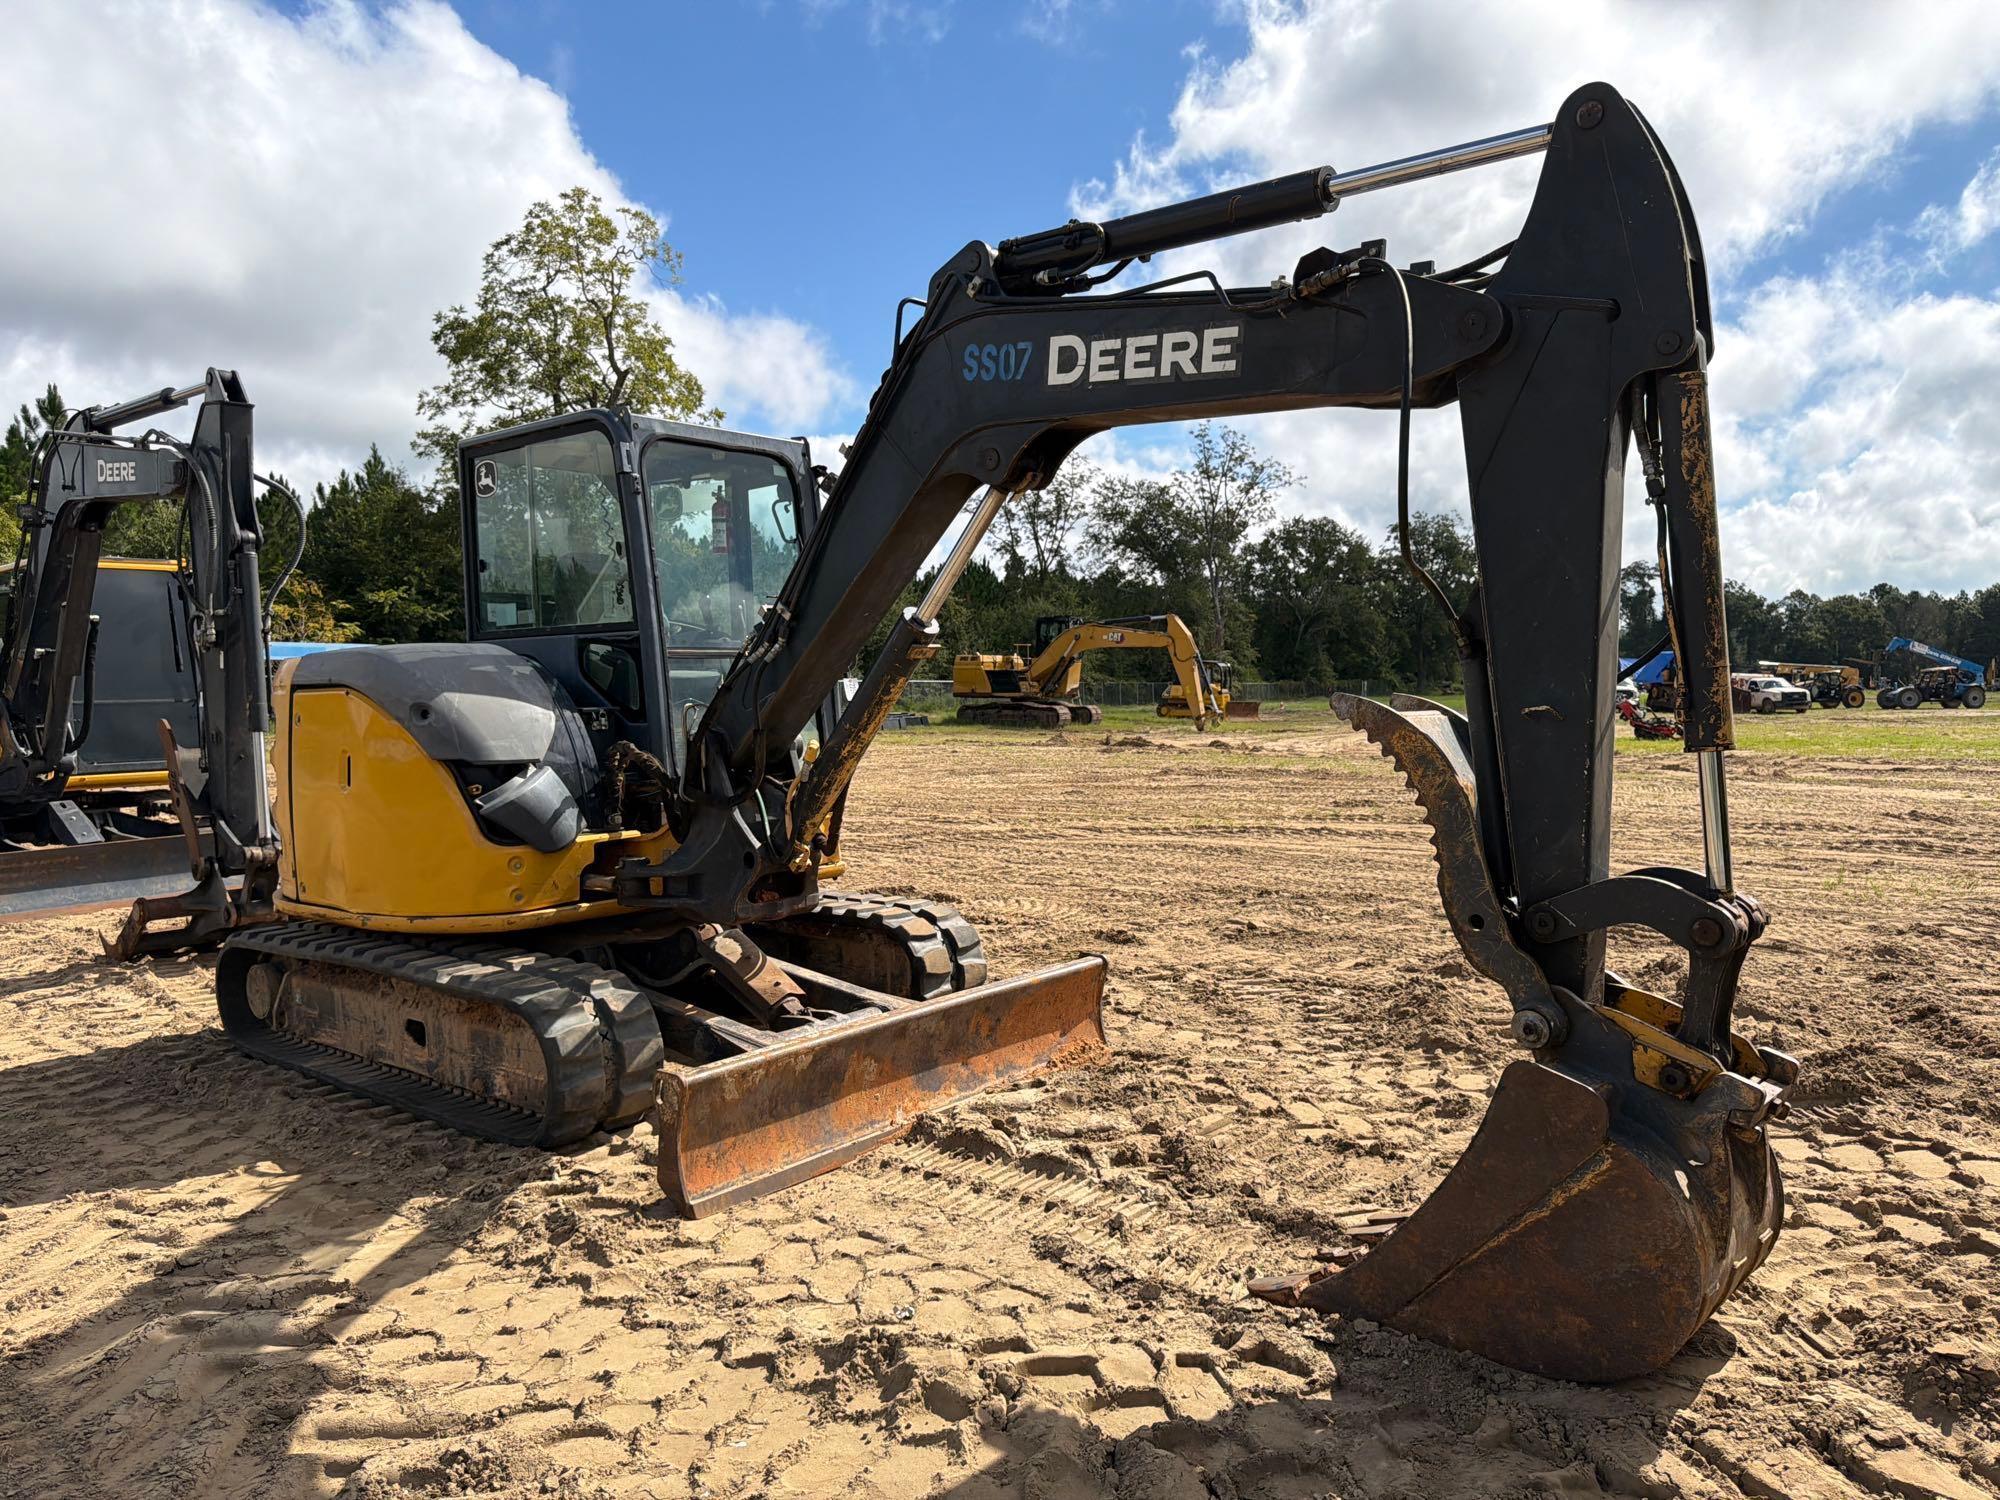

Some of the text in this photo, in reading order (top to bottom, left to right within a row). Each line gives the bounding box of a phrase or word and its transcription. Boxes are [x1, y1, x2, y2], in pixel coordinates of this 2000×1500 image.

[962, 341, 1033, 382] SS07
[1047, 326, 1240, 386] DEERE
[97, 459, 136, 482] DEERE
[1108, 632, 1121, 642] CAT
